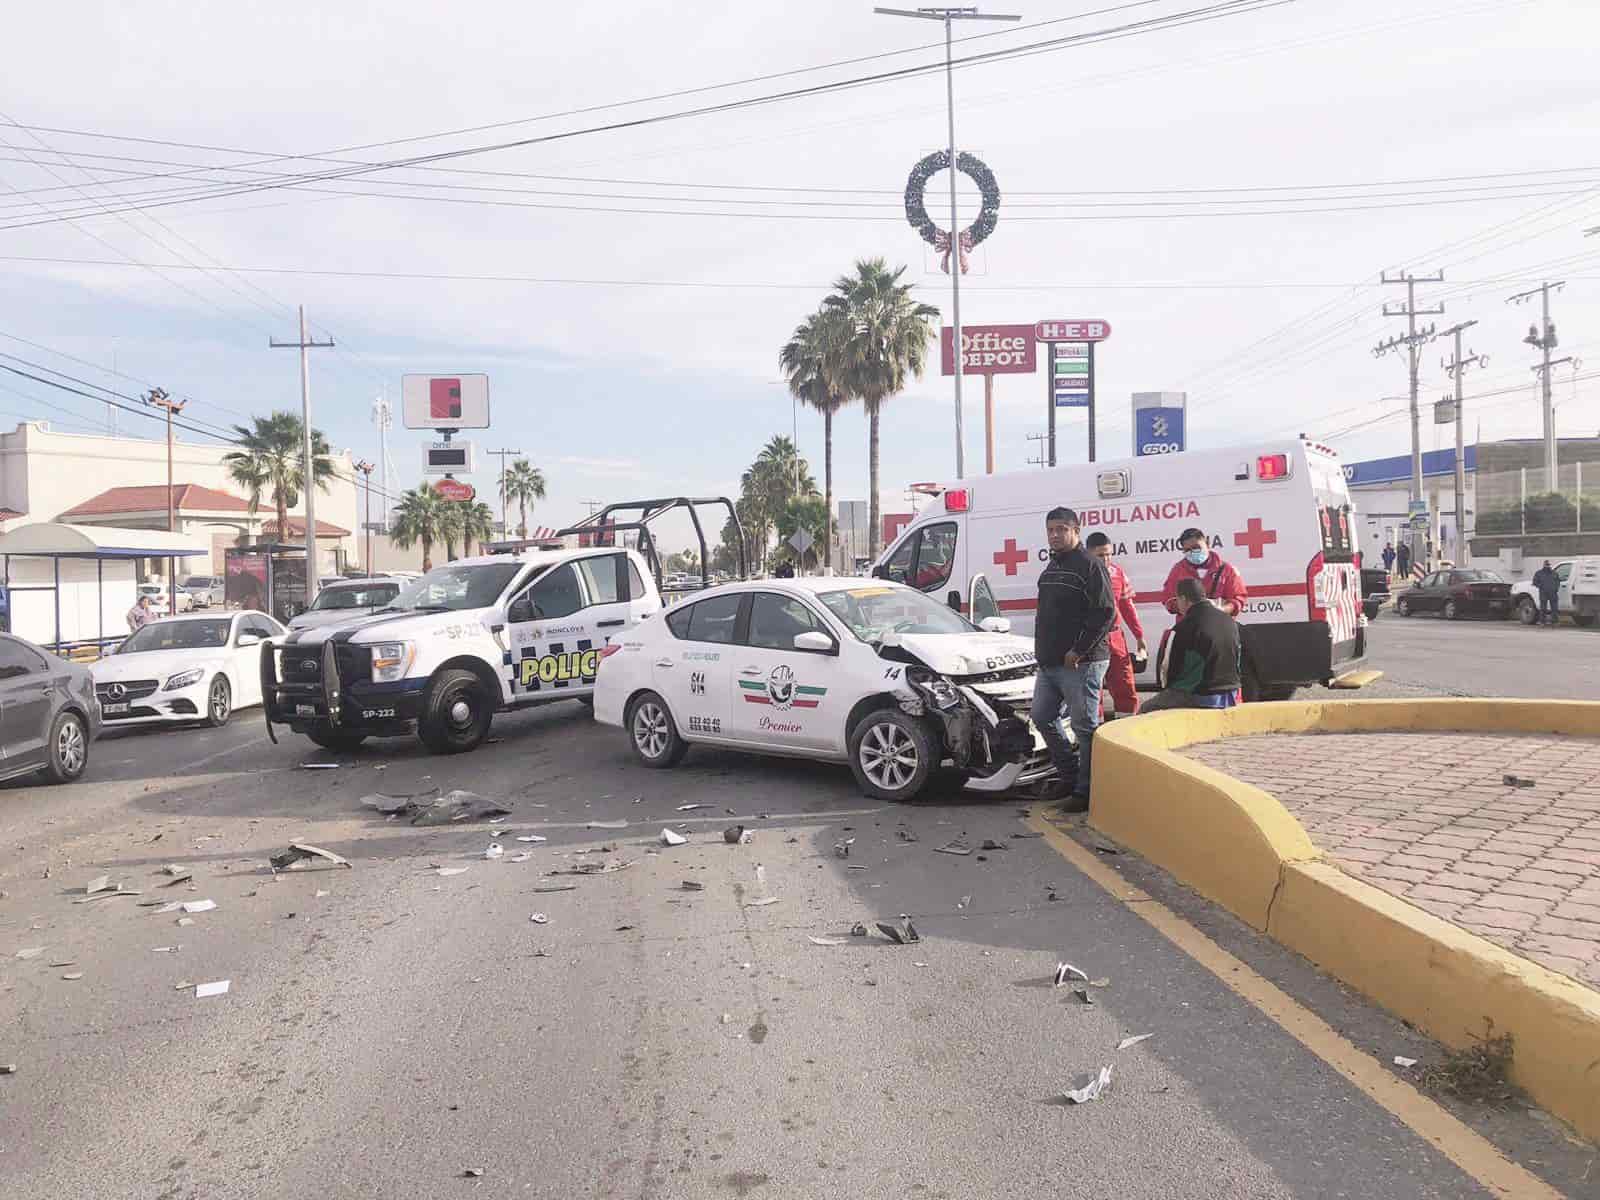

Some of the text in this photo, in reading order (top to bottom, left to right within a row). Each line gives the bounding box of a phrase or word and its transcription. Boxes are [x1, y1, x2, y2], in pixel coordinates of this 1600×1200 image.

[1142, 442, 1178, 454] G500
[1075, 500, 1201, 528] MBULANCIA
[521, 650, 599, 686] POLIC
[362, 709, 395, 719] SP-222
[759, 716, 802, 733] Premier
